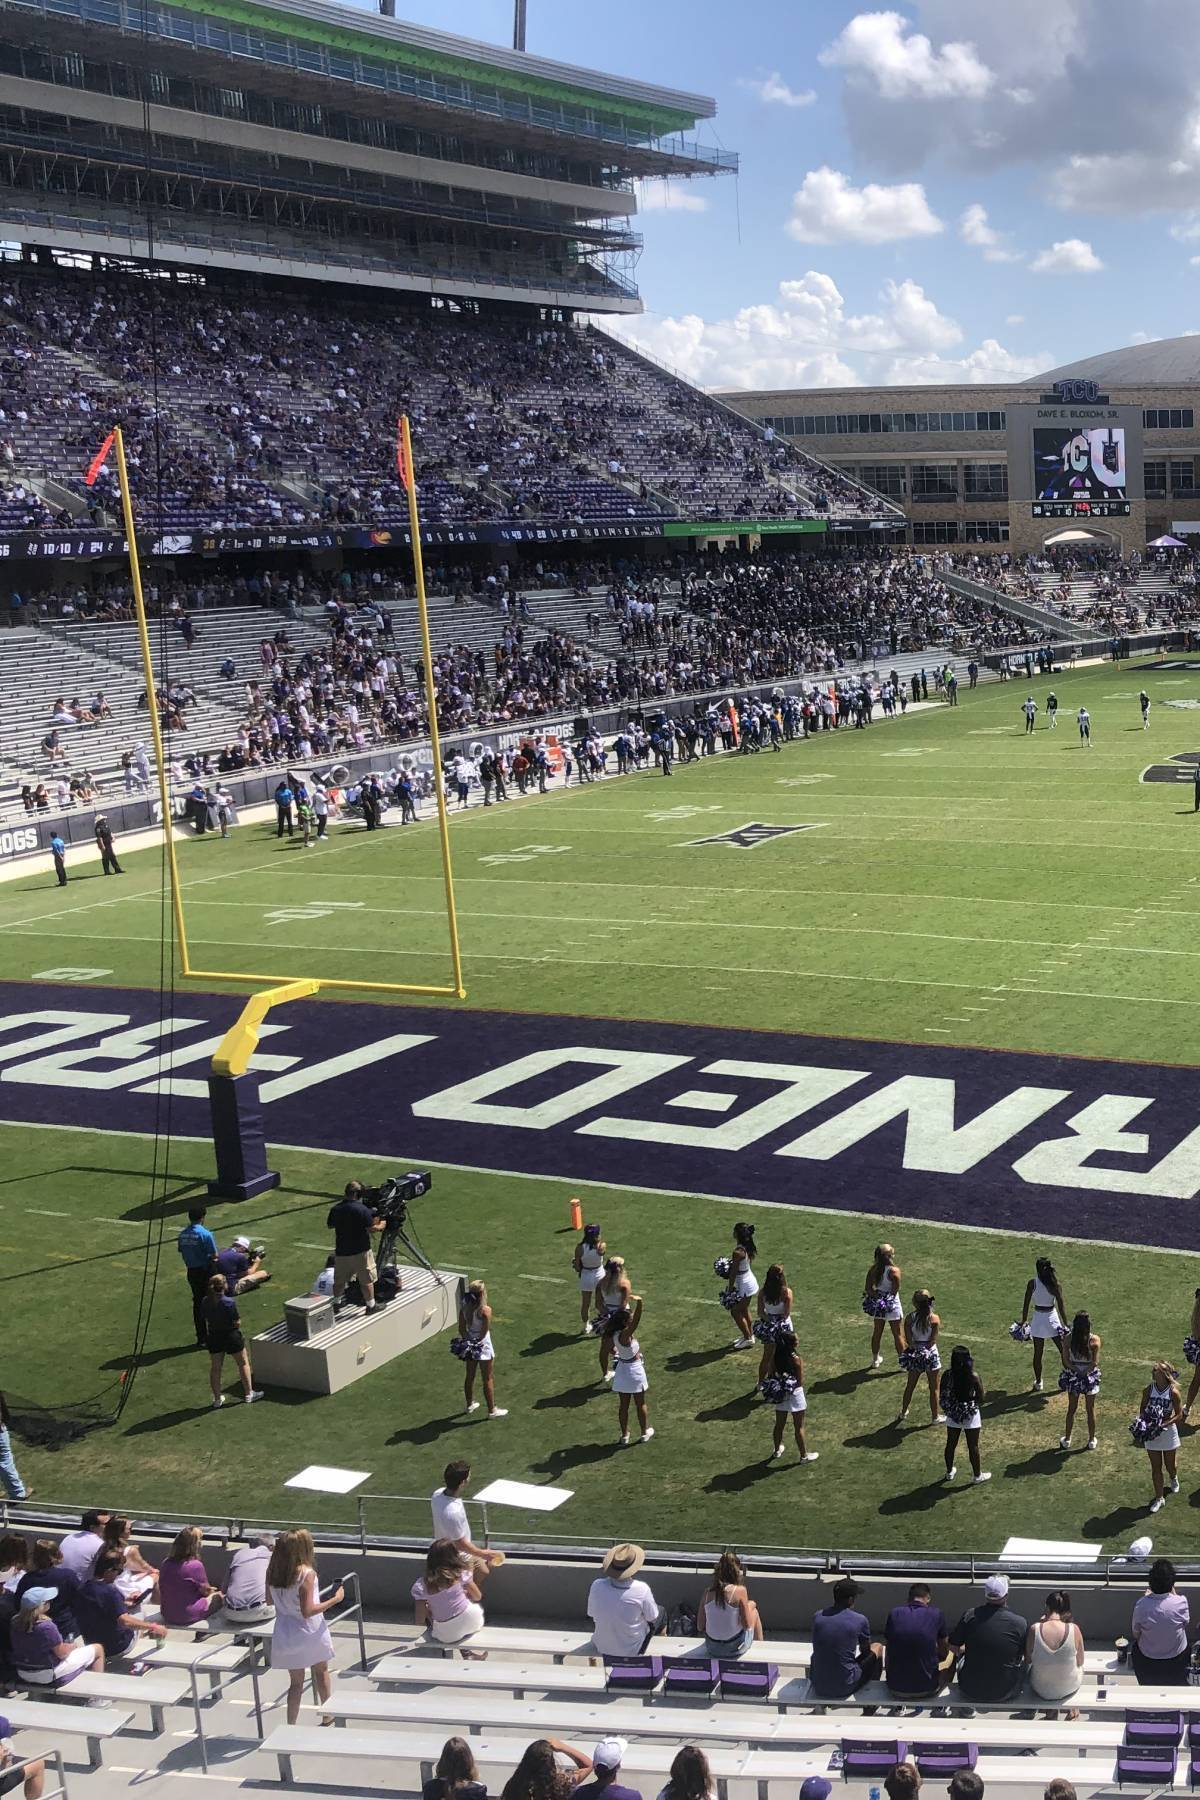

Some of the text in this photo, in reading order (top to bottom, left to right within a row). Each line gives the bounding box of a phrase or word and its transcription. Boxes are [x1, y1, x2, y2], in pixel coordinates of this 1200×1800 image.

[1058, 379, 1100, 403] TCU
[1037, 410, 1057, 418] DAVE
[1070, 410, 1105, 419] BLOXOM,
[1062, 428, 1126, 487] TCU
[43, 543, 71, 555] 10/10
[90, 541, 103, 553] 24
[1008, 651, 1033, 666] HORND
